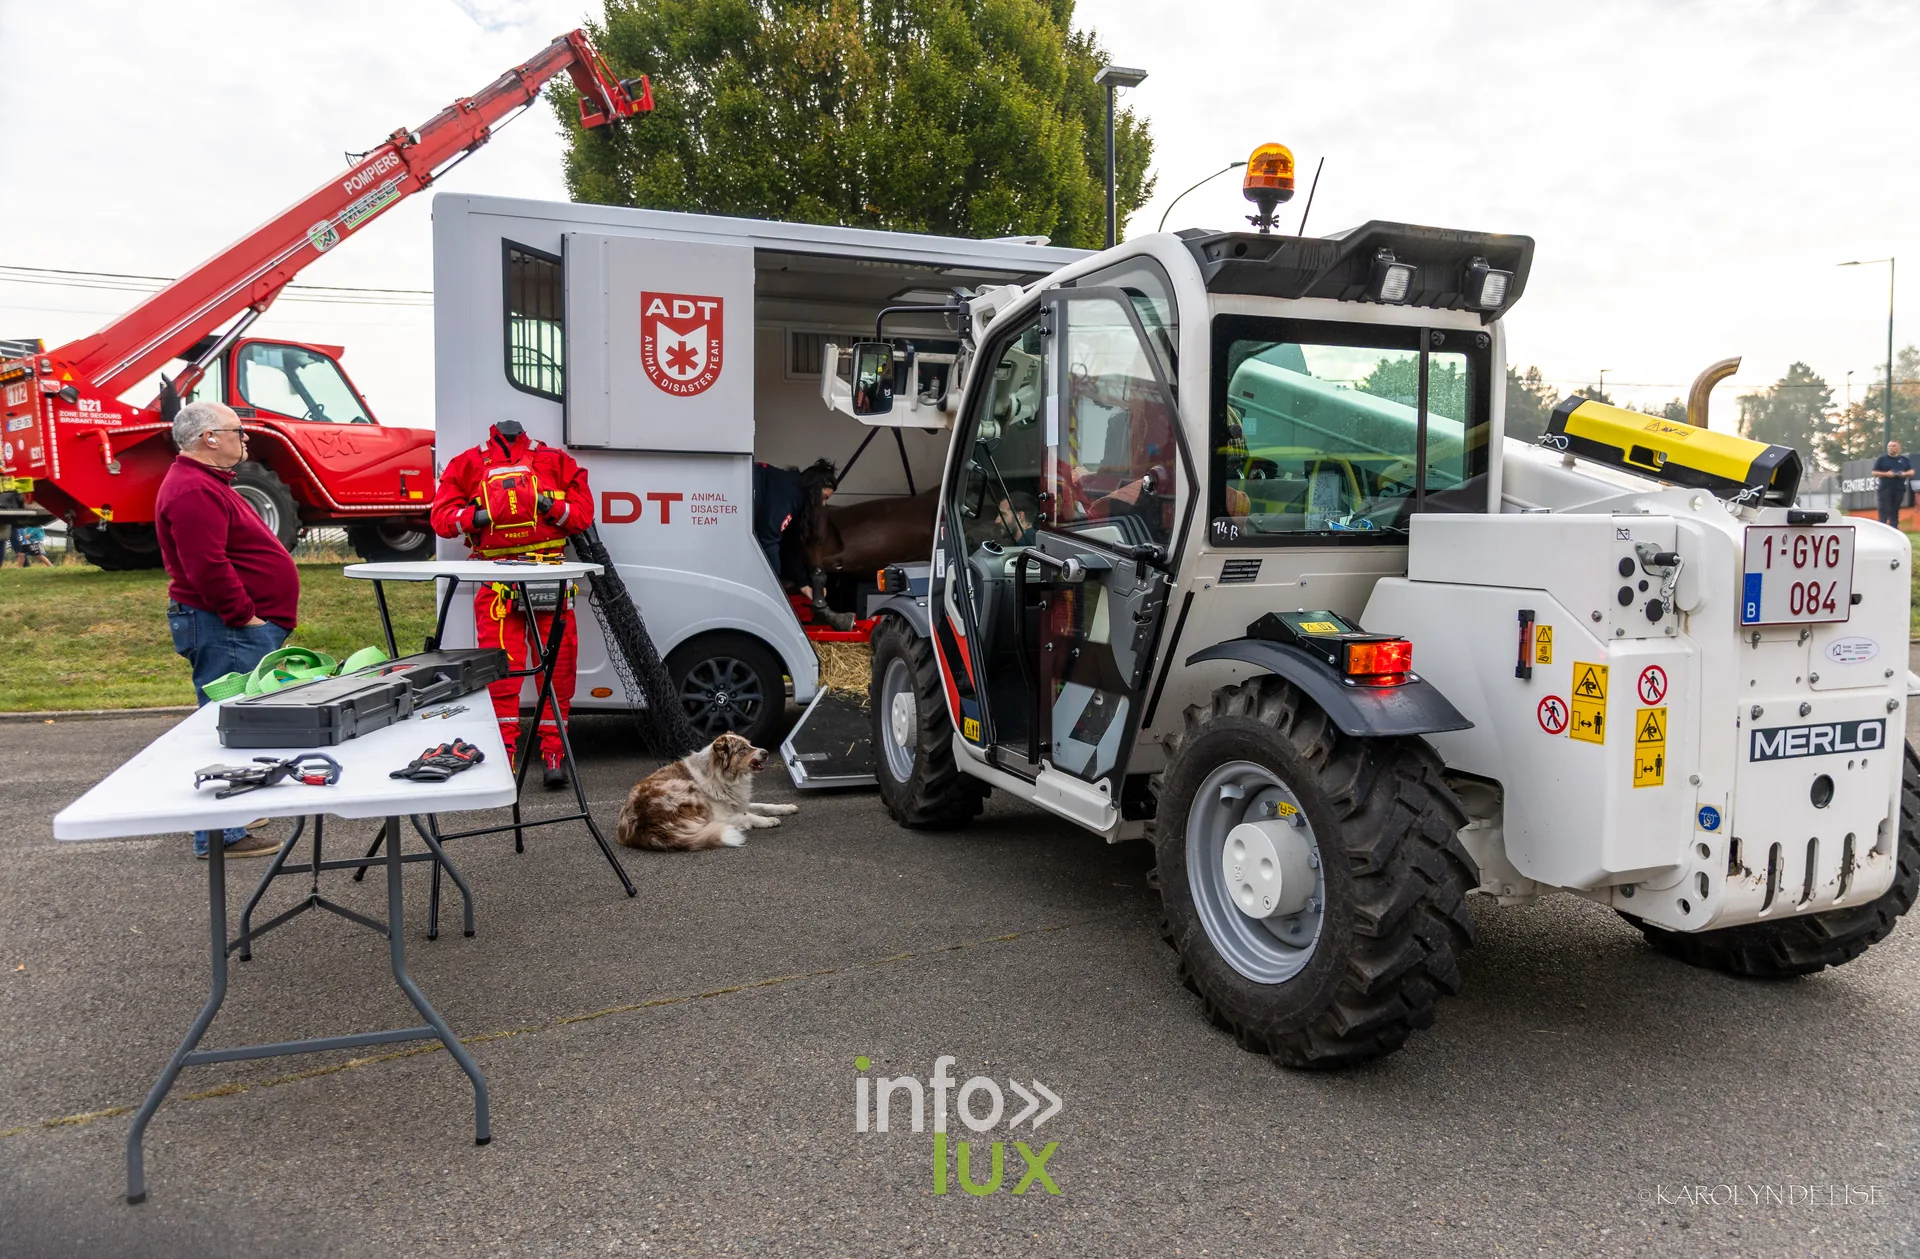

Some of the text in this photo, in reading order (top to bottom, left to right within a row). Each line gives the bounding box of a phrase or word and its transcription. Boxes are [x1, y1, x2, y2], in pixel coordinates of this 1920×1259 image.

[343, 151, 400, 195] POMPIERS
[645, 298, 718, 321] ADT
[644, 335, 719, 393] ANIMAL DISASTER TEAM
[78, 399, 101, 412] G21
[1842, 478, 1865, 493] CENTRE
[1866, 477, 1875, 490] DE
[691, 493, 728, 501] ANIMAL
[691, 504, 738, 514] DISASTER
[692, 516, 718, 525] TEAM
[1763, 534, 1840, 569] 1-GYG
[1790, 580, 1837, 615] 084
[1746, 602, 1756, 618] B
[1754, 721, 1882, 759] MERLO
